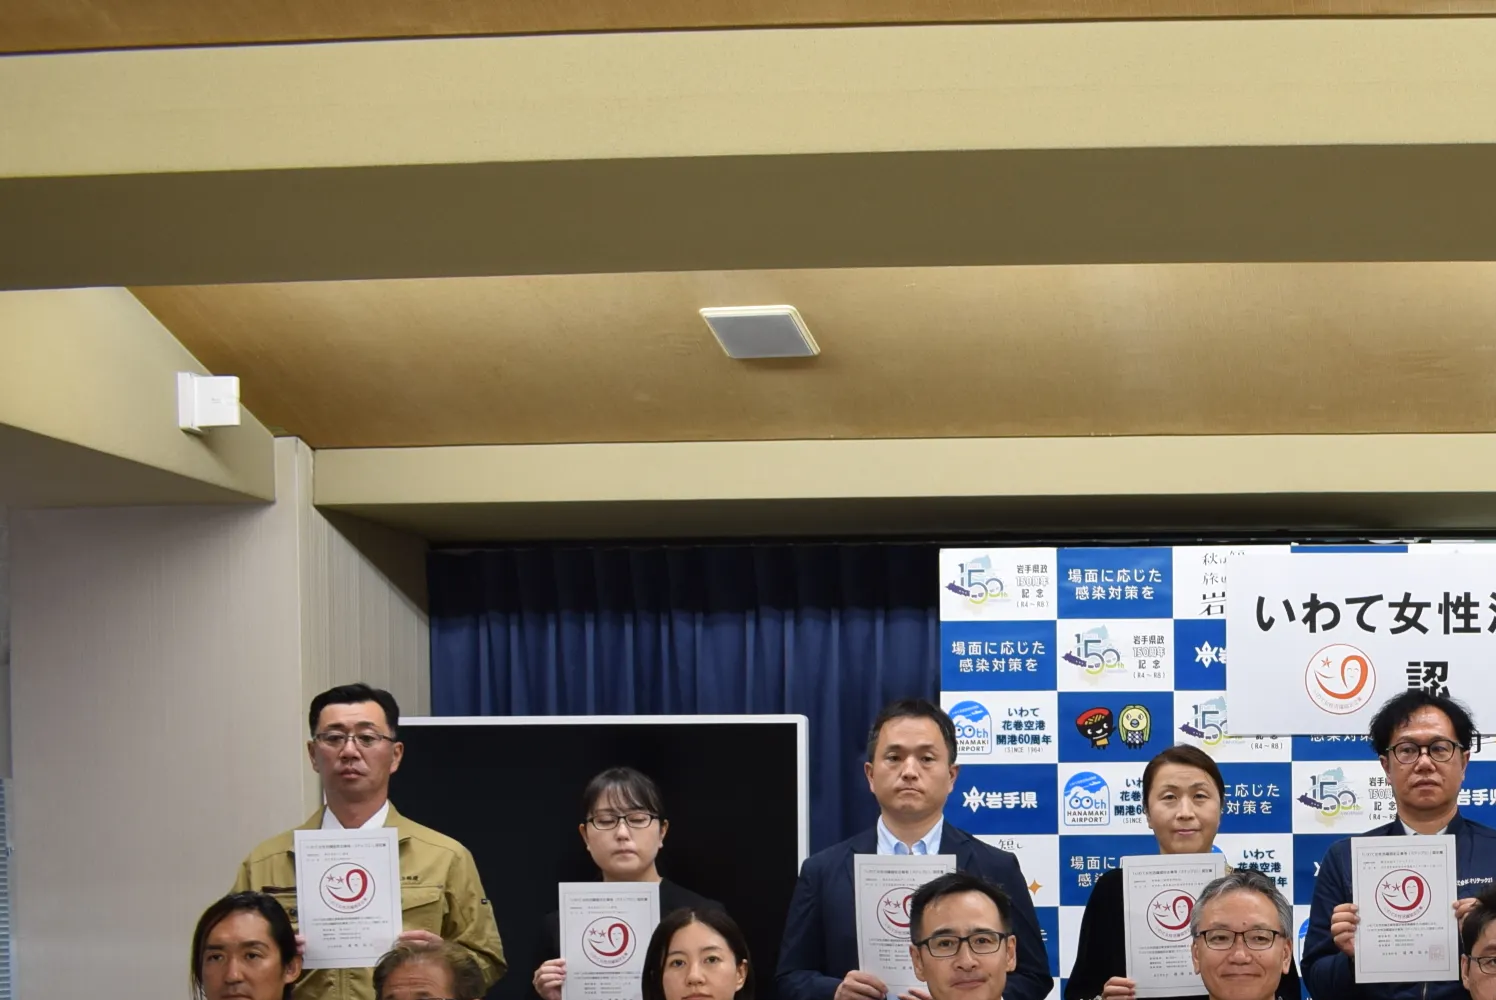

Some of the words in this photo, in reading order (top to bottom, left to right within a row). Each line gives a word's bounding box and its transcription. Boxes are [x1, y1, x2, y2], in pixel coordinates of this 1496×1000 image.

[1016, 564, 1048, 574] 岩手県政
[1068, 568, 1162, 582] 場面に応じた
[1016, 576, 1049, 586] 150周年
[1075, 586, 1154, 600] 感染対策を
[1133, 635, 1165, 645] 岩手県政
[951, 640, 1046, 655] 場面に応じた
[1132, 646, 1166, 658] 150周年
[958, 658, 1038, 672] 感染対策を
[1008, 707, 1040, 717] いわて
[1002, 720, 1046, 730] 花巻空港
[996, 734, 1052, 745] 開港60周年
[986, 792, 1038, 809] 岩手県
[1120, 790, 1143, 802] 花巻
[1226, 800, 1272, 815] 対策を
[1242, 850, 1276, 860] いわて
[1237, 862, 1282, 873] 花巻空港
